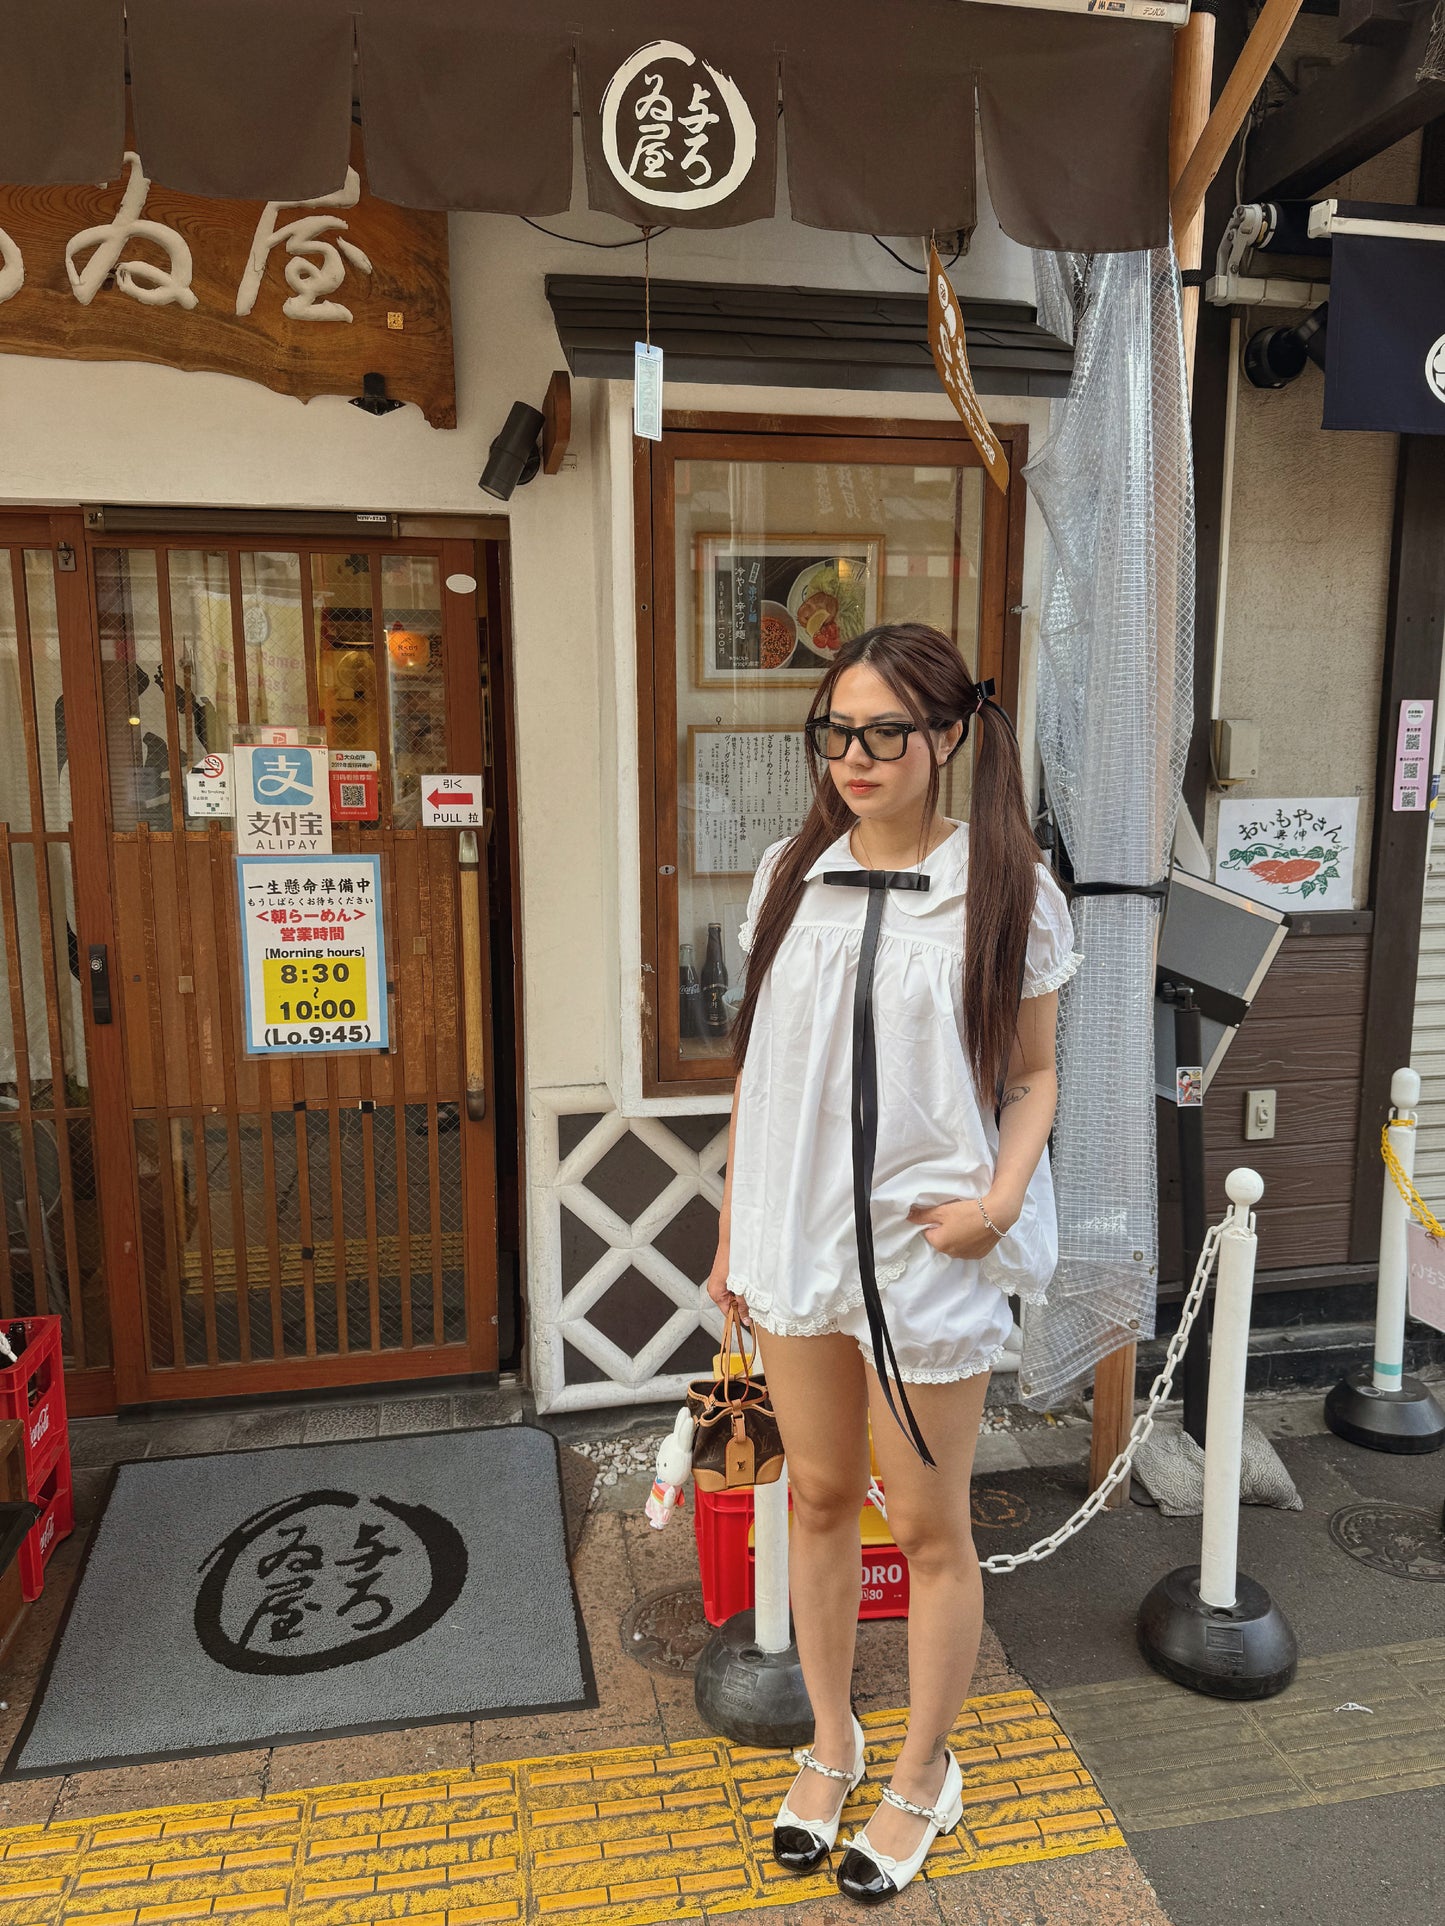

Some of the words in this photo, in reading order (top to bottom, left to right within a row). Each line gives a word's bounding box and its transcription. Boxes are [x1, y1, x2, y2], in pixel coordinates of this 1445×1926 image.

[443, 779, 462, 789] 引く
[247, 811, 323, 836] 支付宝
[433, 813, 463, 823] PULL
[468, 812, 479, 823] 拉
[1238, 808, 1343, 844] おいもやさん
[256, 839, 317, 850] ALIPAY
[248, 878, 371, 895] 一生懸命準備中
[248, 897, 374, 907] もうしばらくお待ちください
[280, 926, 345, 942] 営業時間
[281, 963, 349, 984] 8:30
[280, 999, 355, 1020] 10:00
[264, 1025, 371, 1047] (Lo.9:45)
[869, 1589, 883, 1600] 30
